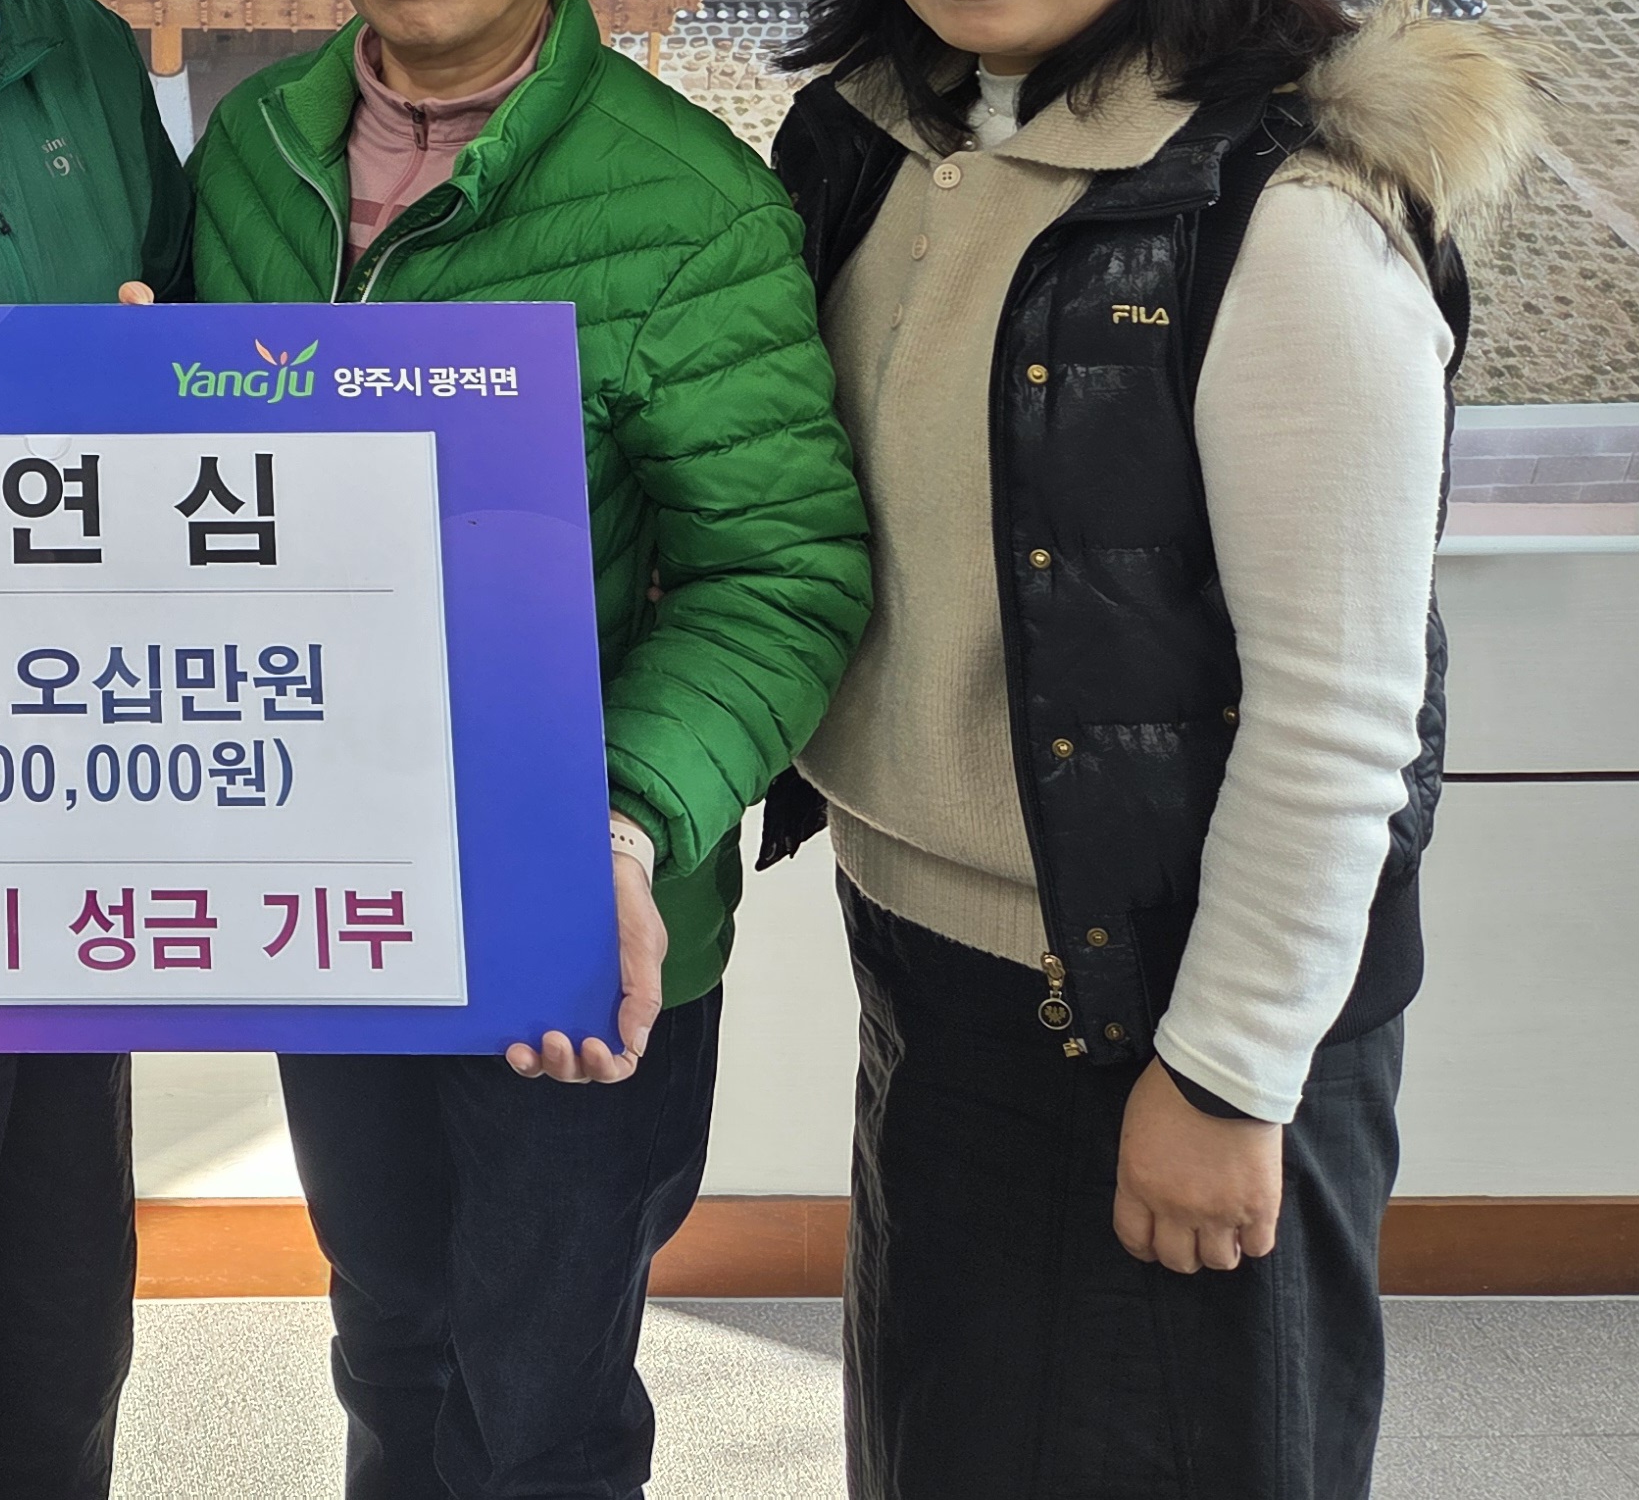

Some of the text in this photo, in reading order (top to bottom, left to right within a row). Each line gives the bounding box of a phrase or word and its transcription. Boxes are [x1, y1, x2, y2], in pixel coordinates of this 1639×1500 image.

[1111, 304, 1170, 325] FILA
[333, 366, 519, 398] 양주시 광적면
[11, 643, 325, 725] 오십만원
[68, 887, 218, 971] 성금
[262, 887, 413, 970] 기부
